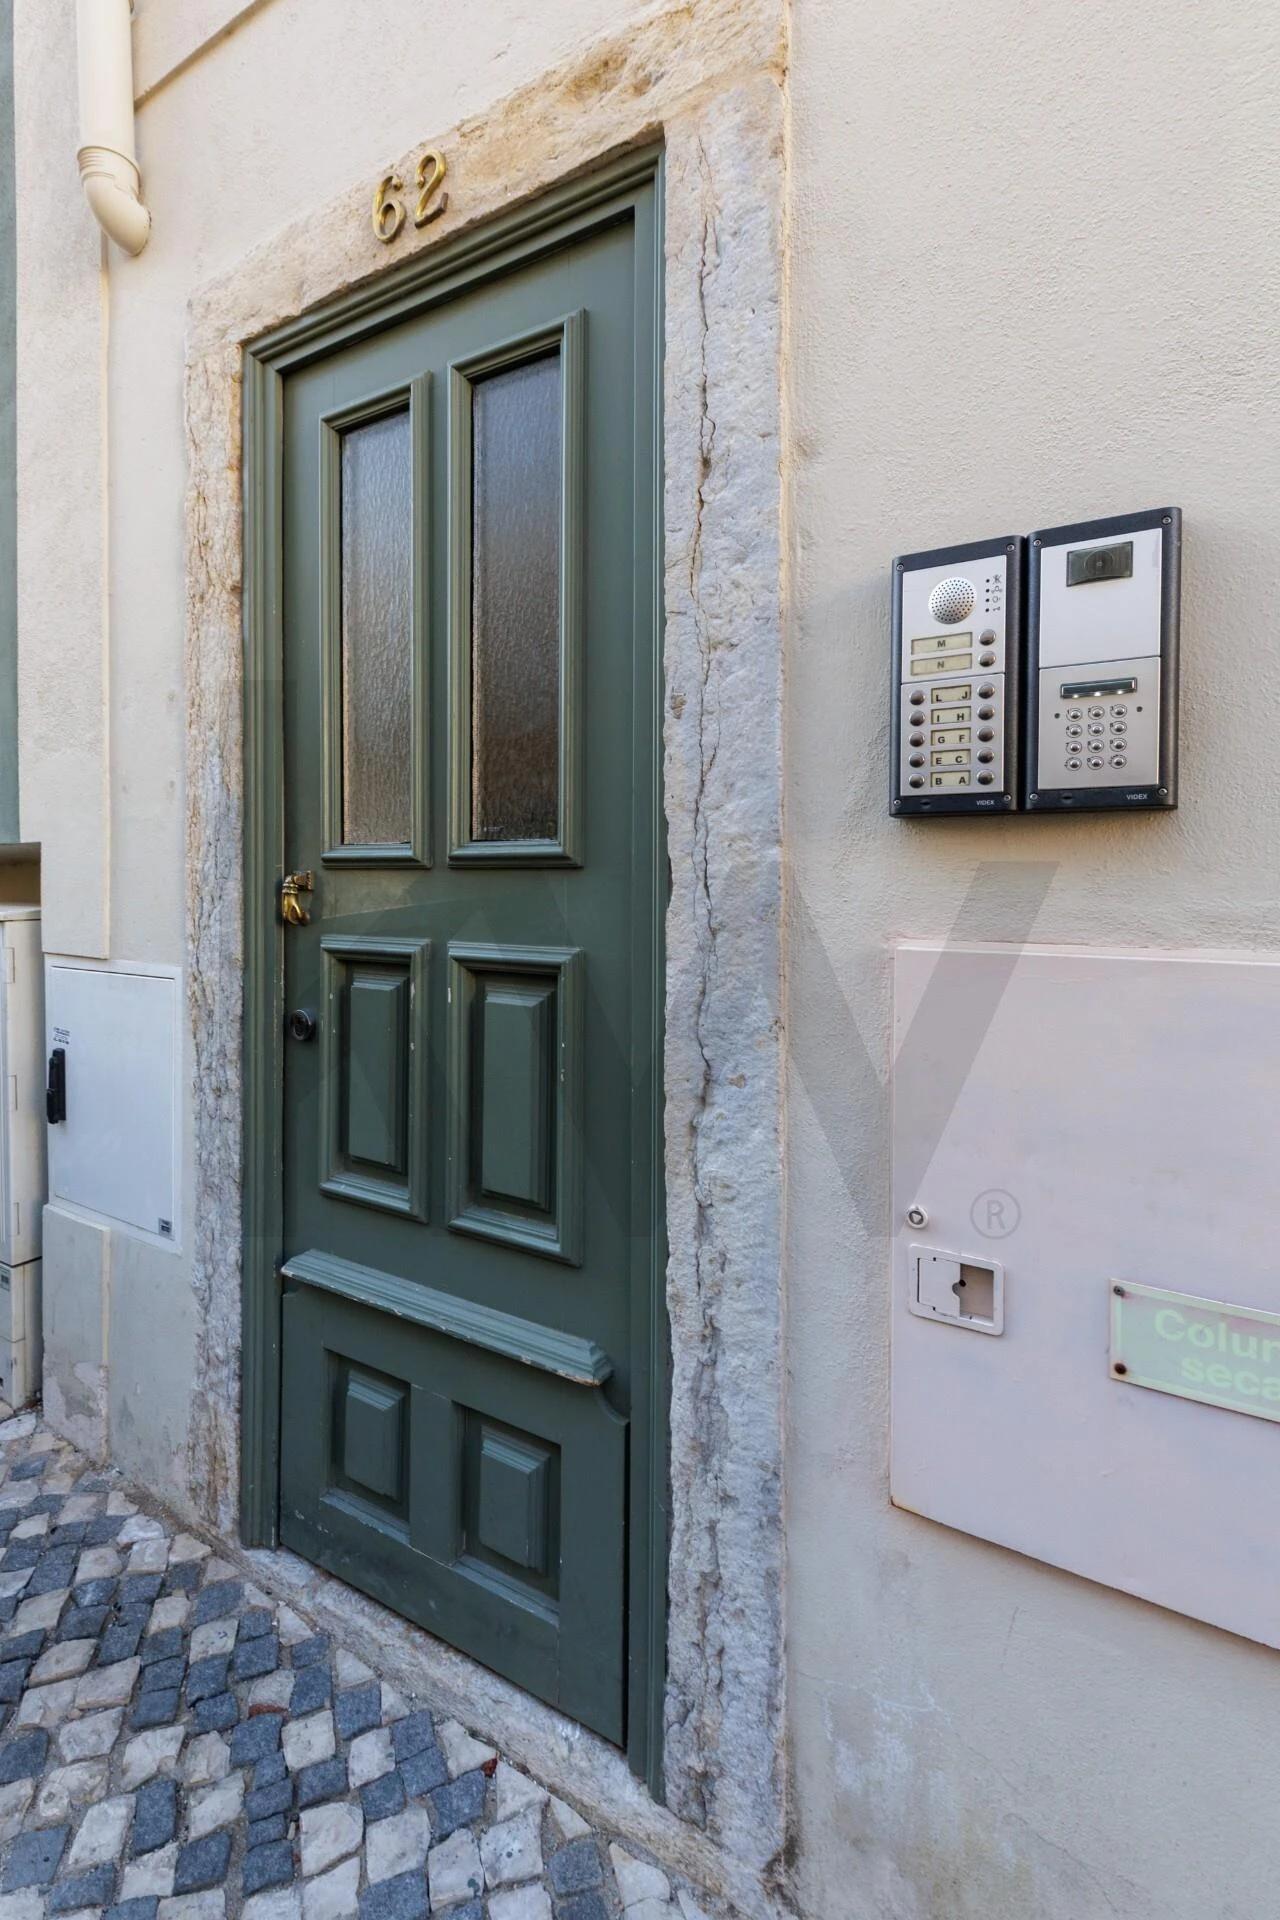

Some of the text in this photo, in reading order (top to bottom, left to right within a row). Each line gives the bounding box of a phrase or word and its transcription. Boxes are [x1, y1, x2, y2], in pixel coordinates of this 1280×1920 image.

[373, 151, 448, 242] 62
[937, 640, 946, 648] M
[937, 661, 945, 669] N
[936, 691, 968, 702] L J
[956, 712, 964, 721] H
[937, 734, 965, 744] G F
[936, 755, 963, 765] E C
[935, 776, 967, 785] B A
